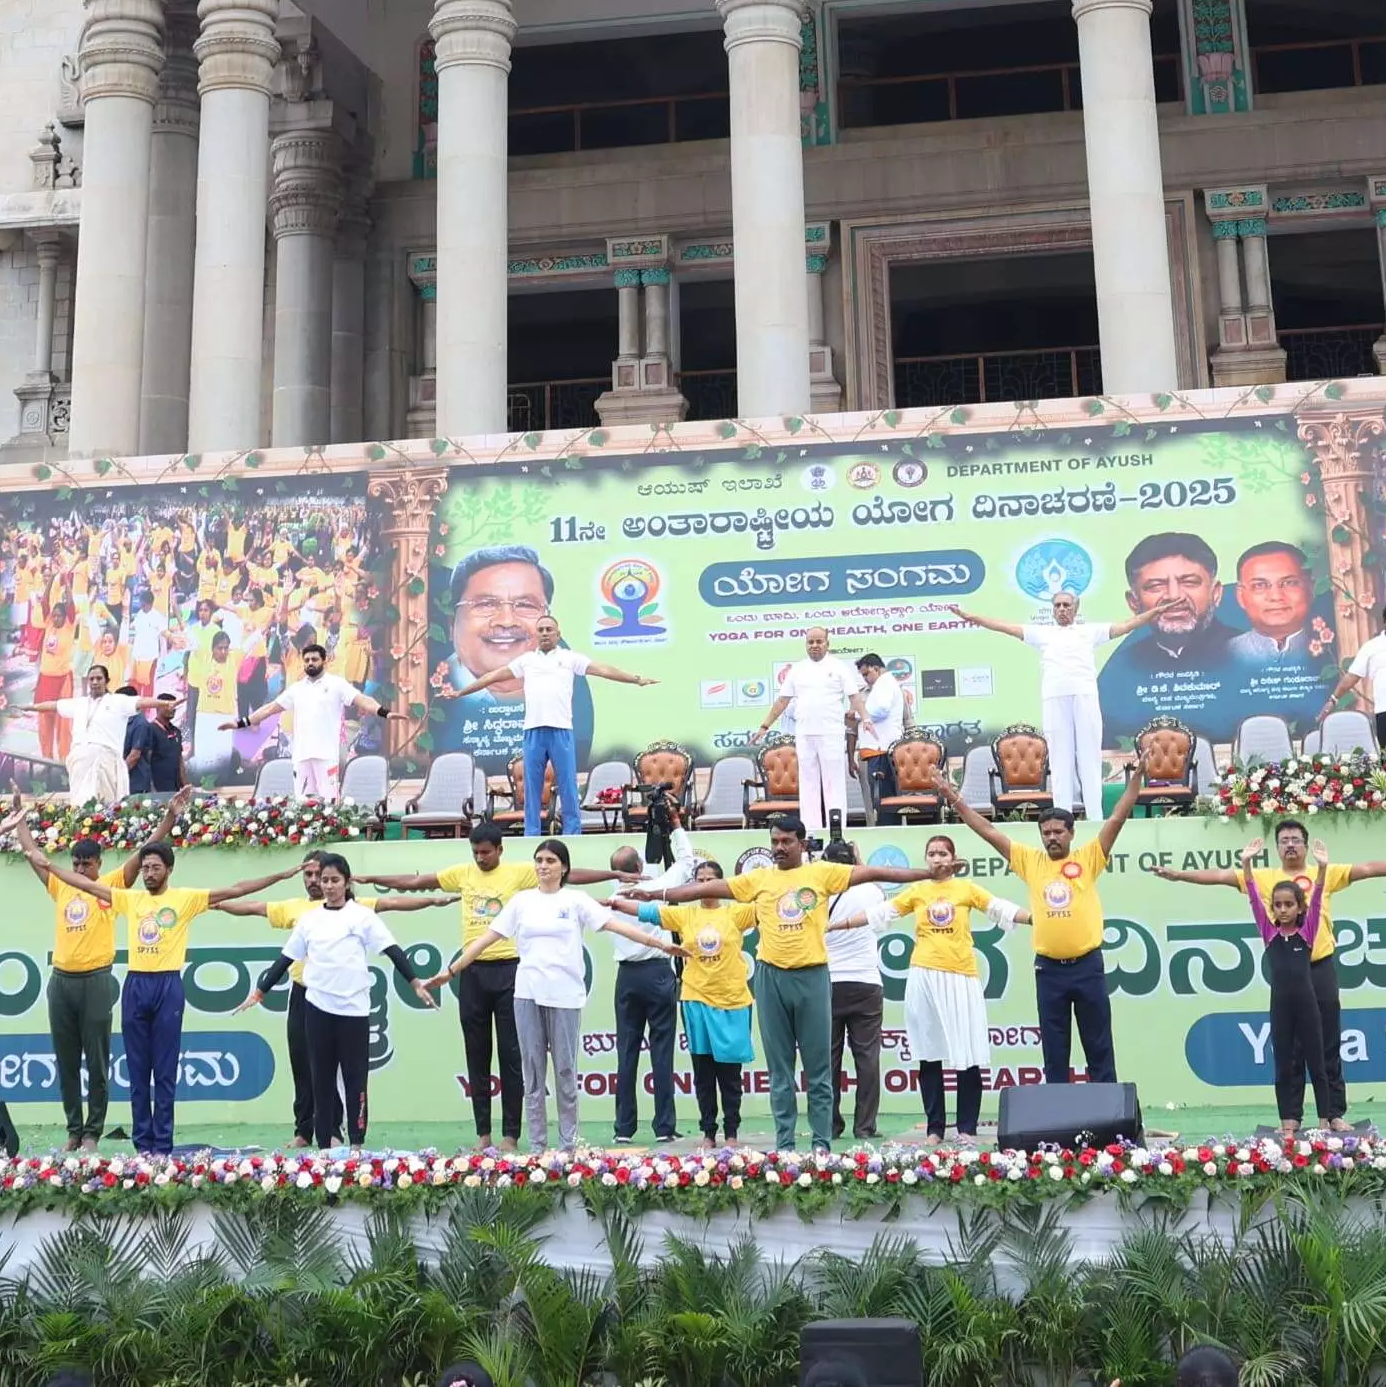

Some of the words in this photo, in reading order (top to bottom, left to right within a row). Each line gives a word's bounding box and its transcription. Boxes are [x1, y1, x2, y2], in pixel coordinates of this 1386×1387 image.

[946, 458, 1063, 478] DEPARTMENT
[1067, 457, 1091, 472] OF
[1096, 453, 1154, 470] AYUSH
[637, 478, 710, 496] ಆಯುಷ್
[722, 473, 783, 492] ಇಲಾಖೆ
[549, 515, 606, 543] 11ನೇ
[622, 500, 835, 551] ಅಂತಾರಾಷ್ಟ್ರೀಯ
[851, 493, 954, 526] ಯೋಗ
[713, 566, 830, 597] ಯೋಗ
[845, 564, 971, 595] ಸಂಗಮ
[709, 632, 749, 641] YOGA
[754, 629, 784, 639] FOR
[892, 622, 923, 632] ONE
[1139, 852, 1173, 872] OF
